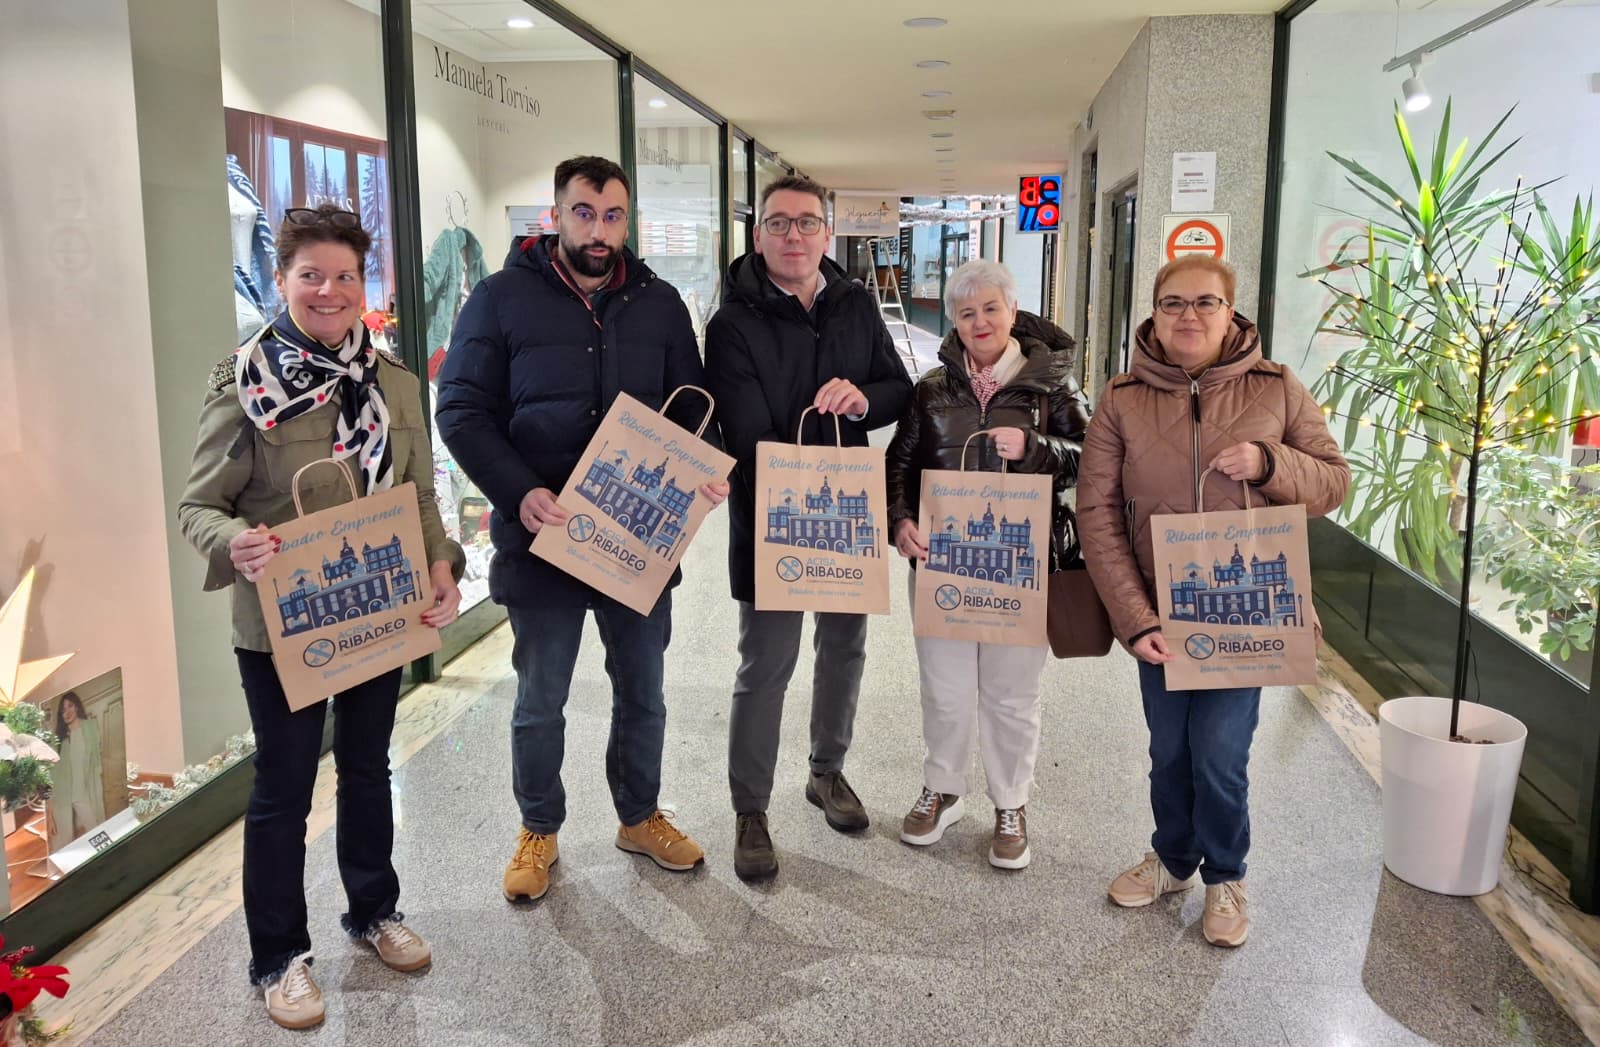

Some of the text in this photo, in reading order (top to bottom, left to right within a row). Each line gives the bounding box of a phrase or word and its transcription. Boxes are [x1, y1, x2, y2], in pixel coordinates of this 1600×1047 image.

[433, 45, 541, 118] Manuela Torviso
[616, 410, 718, 477] Ribadeo Emprende
[768, 456, 875, 475] Ribadeo Emprende
[930, 482, 1041, 503] Ribadeo Emprende
[281, 504, 405, 553] badeo Emprende
[1164, 522, 1293, 544] Ribadeo Emprende
[592, 534, 646, 571] RIBADEO
[806, 566, 863, 580] RIBADEO
[963, 595, 1021, 610] RIBADEO
[338, 618, 406, 652] RIBADEO
[1218, 639, 1285, 653] RIBADEO
